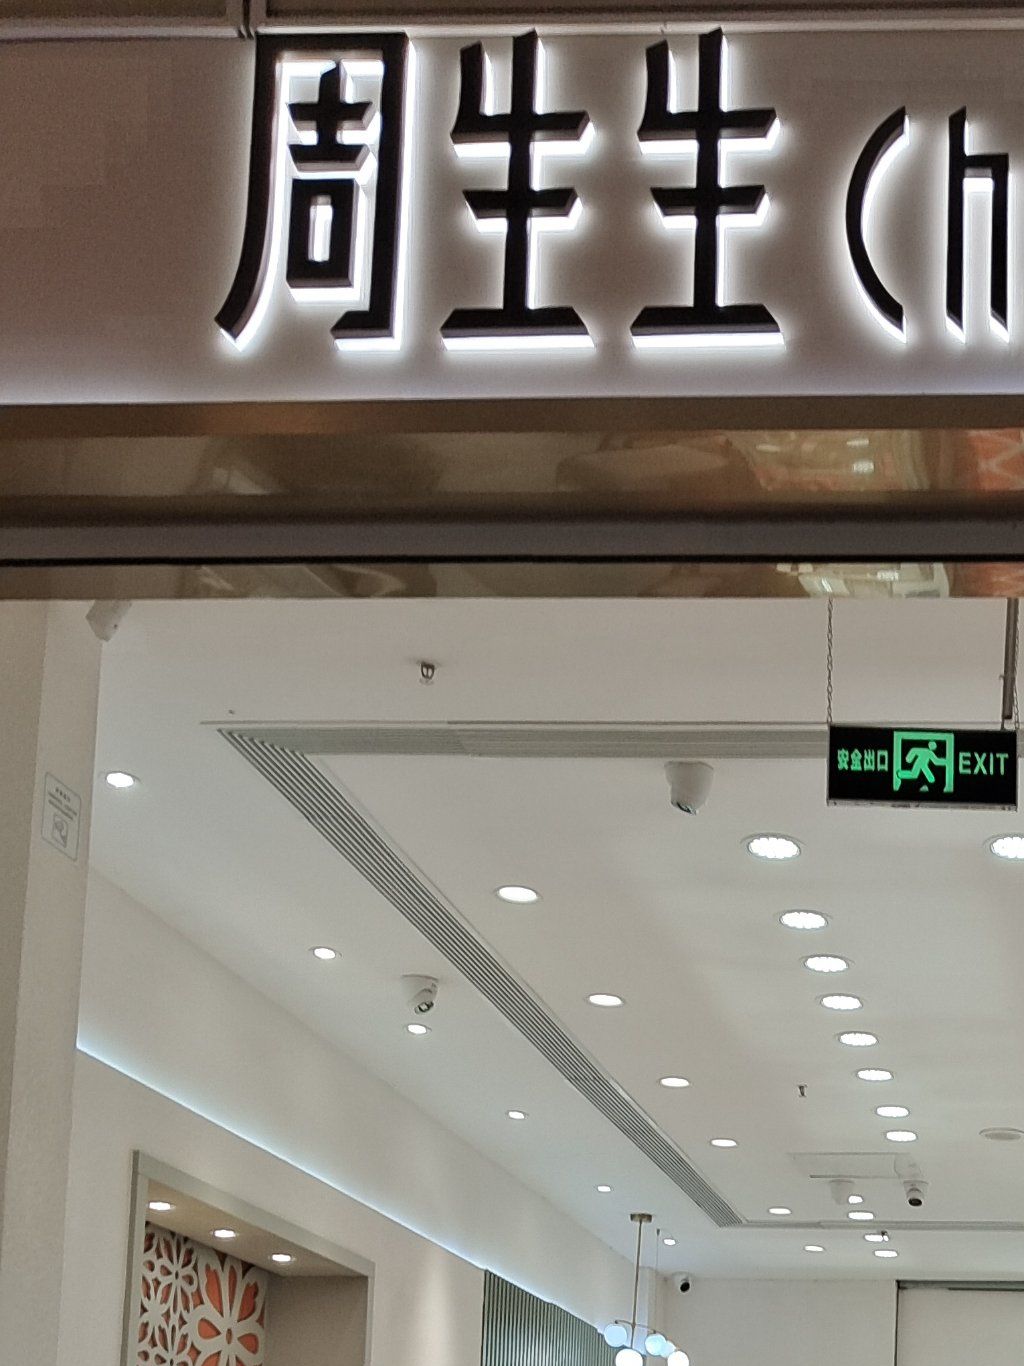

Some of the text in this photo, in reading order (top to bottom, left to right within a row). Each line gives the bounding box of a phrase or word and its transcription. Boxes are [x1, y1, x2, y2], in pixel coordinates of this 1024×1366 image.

[214, 27, 785, 348] 周生生
[837, 748, 1009, 775] 安全出口 EXIT
